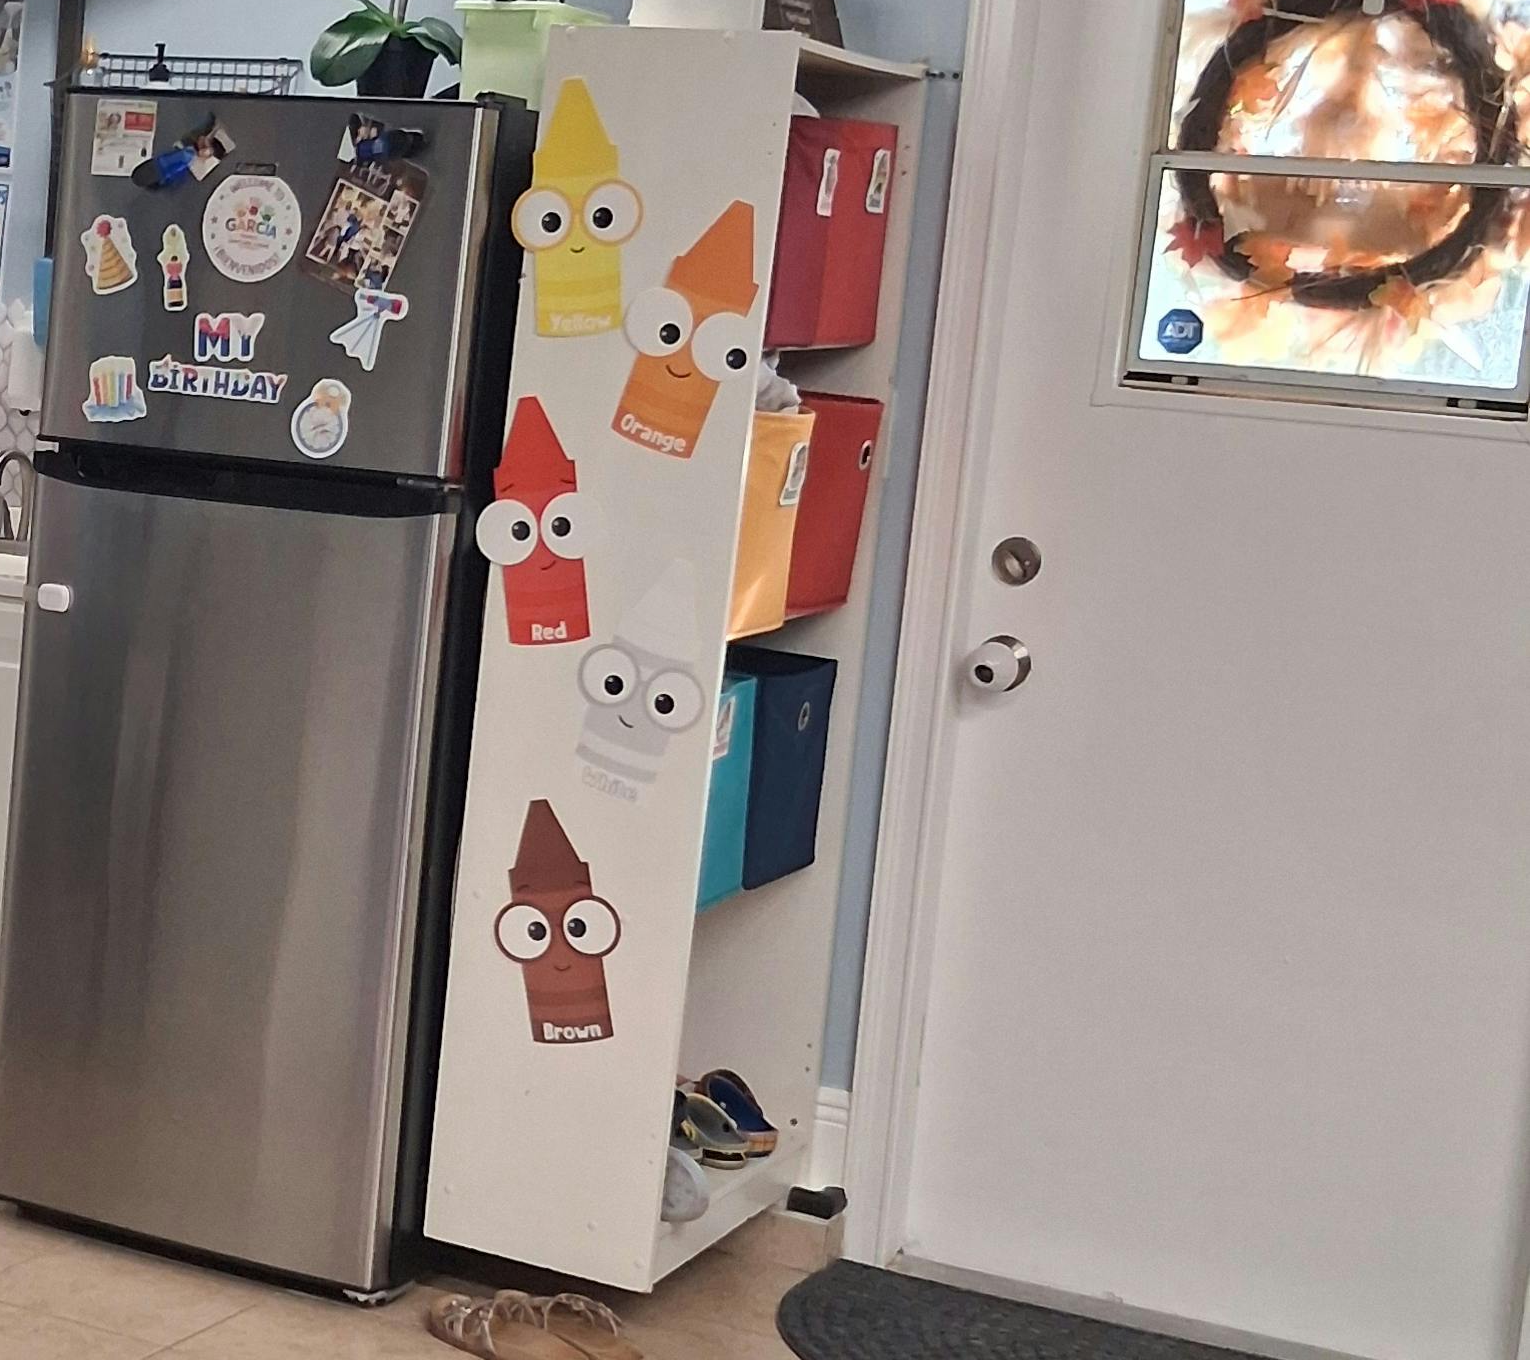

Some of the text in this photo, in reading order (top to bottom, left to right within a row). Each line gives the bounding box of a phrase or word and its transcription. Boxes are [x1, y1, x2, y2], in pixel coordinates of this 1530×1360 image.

[225, 217, 277, 240] GARCIA
[549, 313, 612, 332] Yellow
[1162, 321, 1199, 339] ADT
[198, 315, 263, 357] MY
[150, 361, 287, 401] BIRTHDAY
[620, 413, 687, 452] Orange
[531, 620, 568, 641] Red
[542, 1022, 603, 1041] Brown
